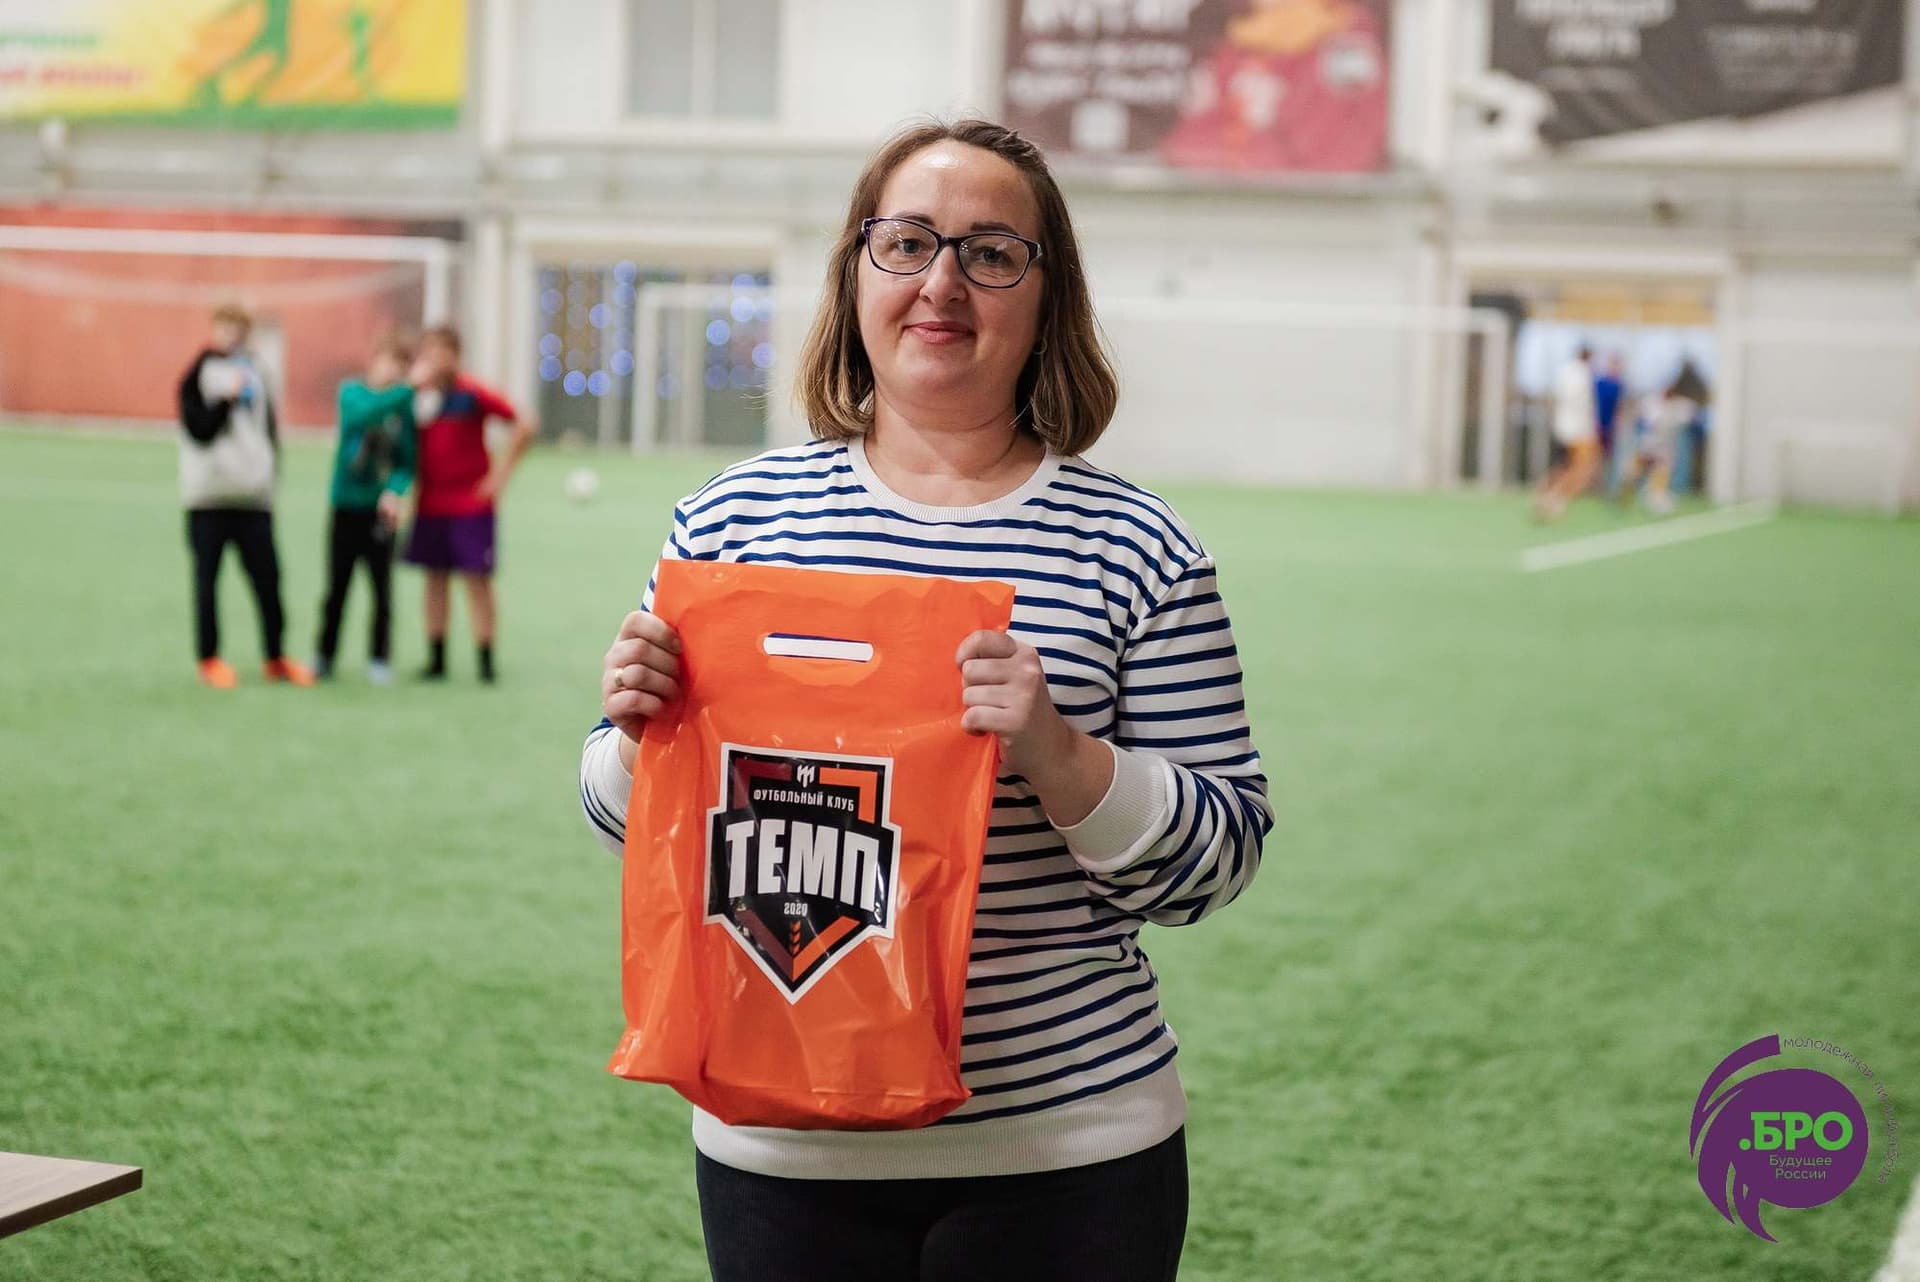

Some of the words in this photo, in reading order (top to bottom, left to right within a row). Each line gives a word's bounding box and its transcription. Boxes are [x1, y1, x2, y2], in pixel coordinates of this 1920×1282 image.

[753, 789, 823, 806] ФУТБОЛЬНЫЙ
[827, 795, 855, 812] КЛУБ
[726, 819, 880, 911] ТЕМП
[784, 902, 808, 917] 2020
